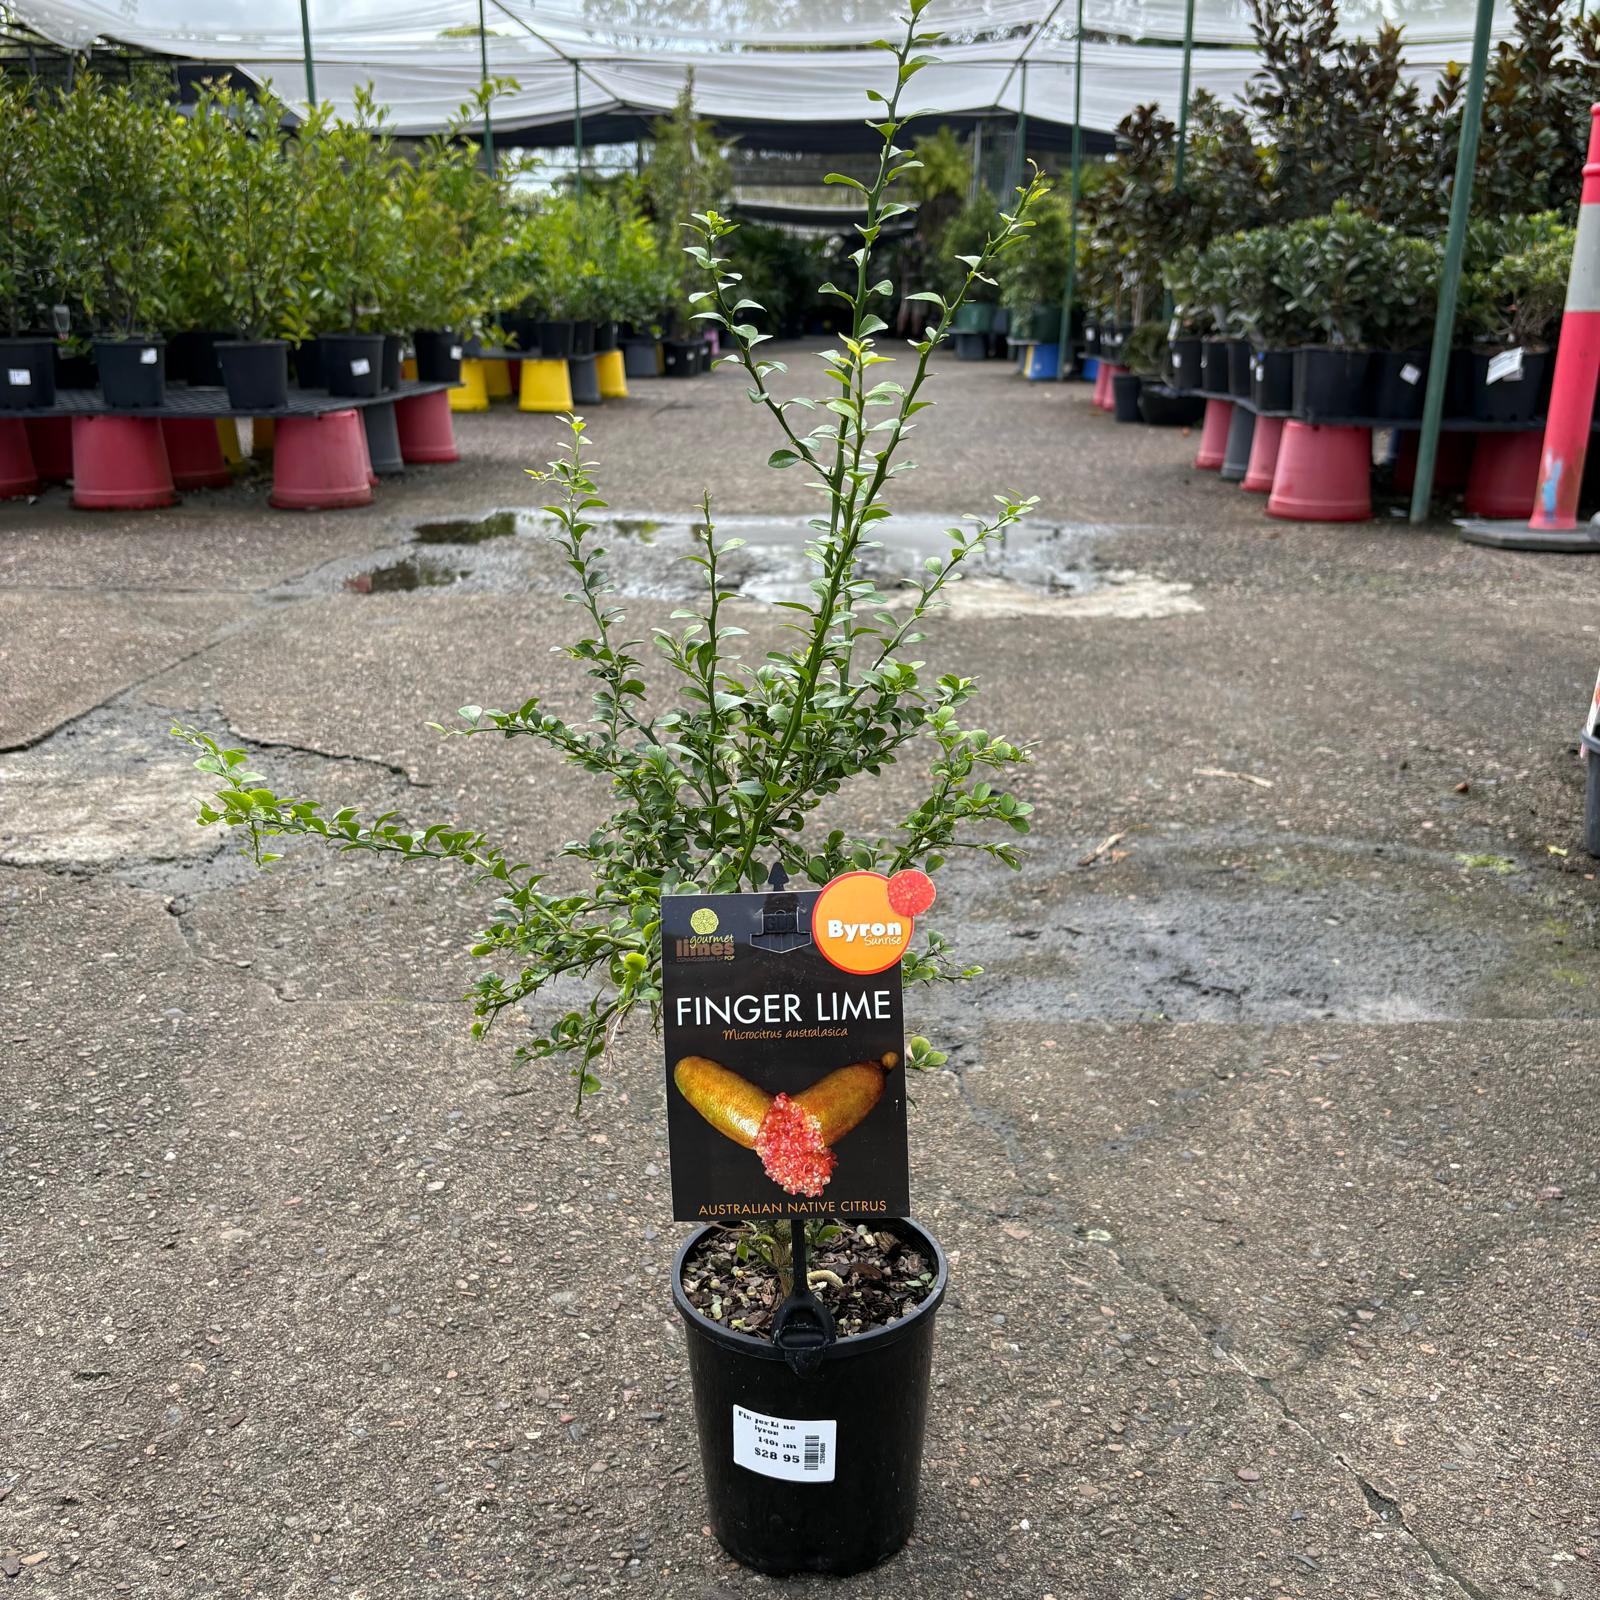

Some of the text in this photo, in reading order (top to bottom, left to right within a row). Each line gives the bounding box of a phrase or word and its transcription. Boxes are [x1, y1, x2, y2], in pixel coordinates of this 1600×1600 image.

[827, 919, 902, 942] Byron
[676, 937, 735, 957] limes
[689, 934, 735, 949] gourmet
[863, 934, 903, 946] Sunrise
[676, 990, 892, 1026] FINGER LIME
[722, 1025, 849, 1042] Microcitrus australasica
[698, 1200, 888, 1216] AUSTRALIAN NATIVE CITRUS
